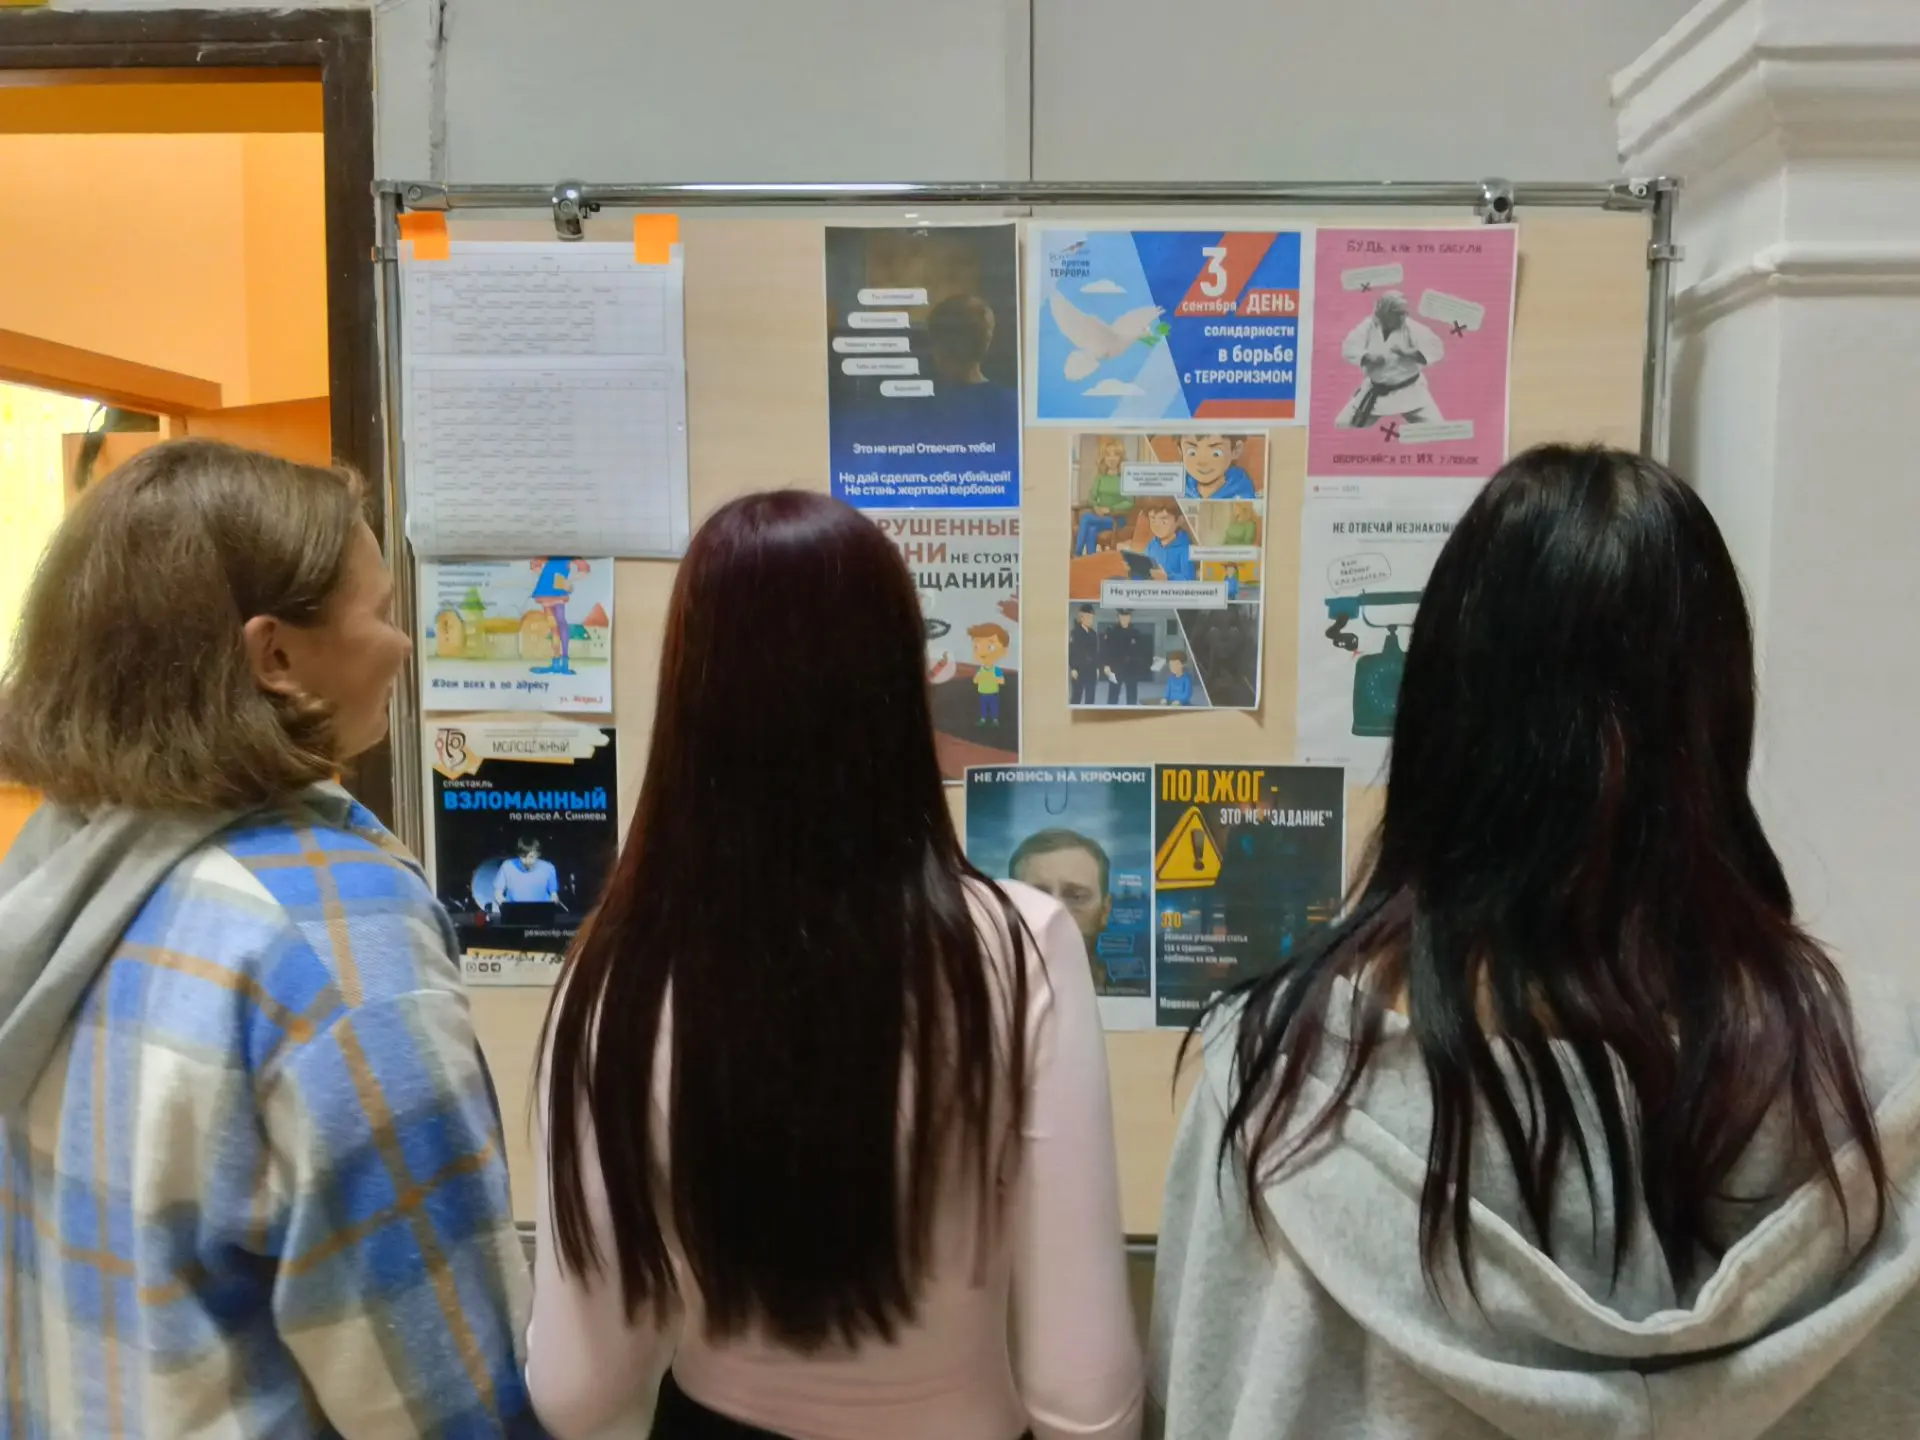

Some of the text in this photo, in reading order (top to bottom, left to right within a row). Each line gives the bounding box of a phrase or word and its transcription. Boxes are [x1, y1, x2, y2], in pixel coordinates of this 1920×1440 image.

[1200, 247, 1227, 297] 3
[1182, 300, 1237, 316] сентября
[1246, 293, 1296, 314] ДЕНЬ
[1204, 325, 1295, 340] солидарности
[1218, 344, 1293, 366] в борьбе
[1184, 369, 1293, 384] с ТЕРРОРИЗМОМ
[853, 442, 996, 457] Это не игра! Отвечать тебе!
[839, 471, 1011, 486] Не дай сделать себя убийцей!
[845, 484, 1005, 497] Не стань жертвой вербовки
[876, 518, 1019, 536] РУШЕННЫЕ
[1333, 522, 1345, 533] НЕ
[1348, 520, 1393, 533] ОТВЕЧАЙ
[903, 542, 947, 564] НИ
[951, 553, 969, 563] НЕ
[912, 567, 1019, 592] ЩАНИЙ!
[1110, 587, 1218, 598] Не упусти мгновение!
[974, 770, 1146, 782] НЕ ЛОВИСЬ НА КРЮЧОК!
[443, 779, 493, 789] спектакль
[1162, 769, 1265, 804] ПОДЖОГ
[443, 786, 607, 810] ВЗЛОМАННЫЙ
[509, 813, 522, 821] по
[524, 813, 551, 821] пьесе
[1220, 807, 1333, 827] ЭТО НЕ "ЗАДАНИЕ"
